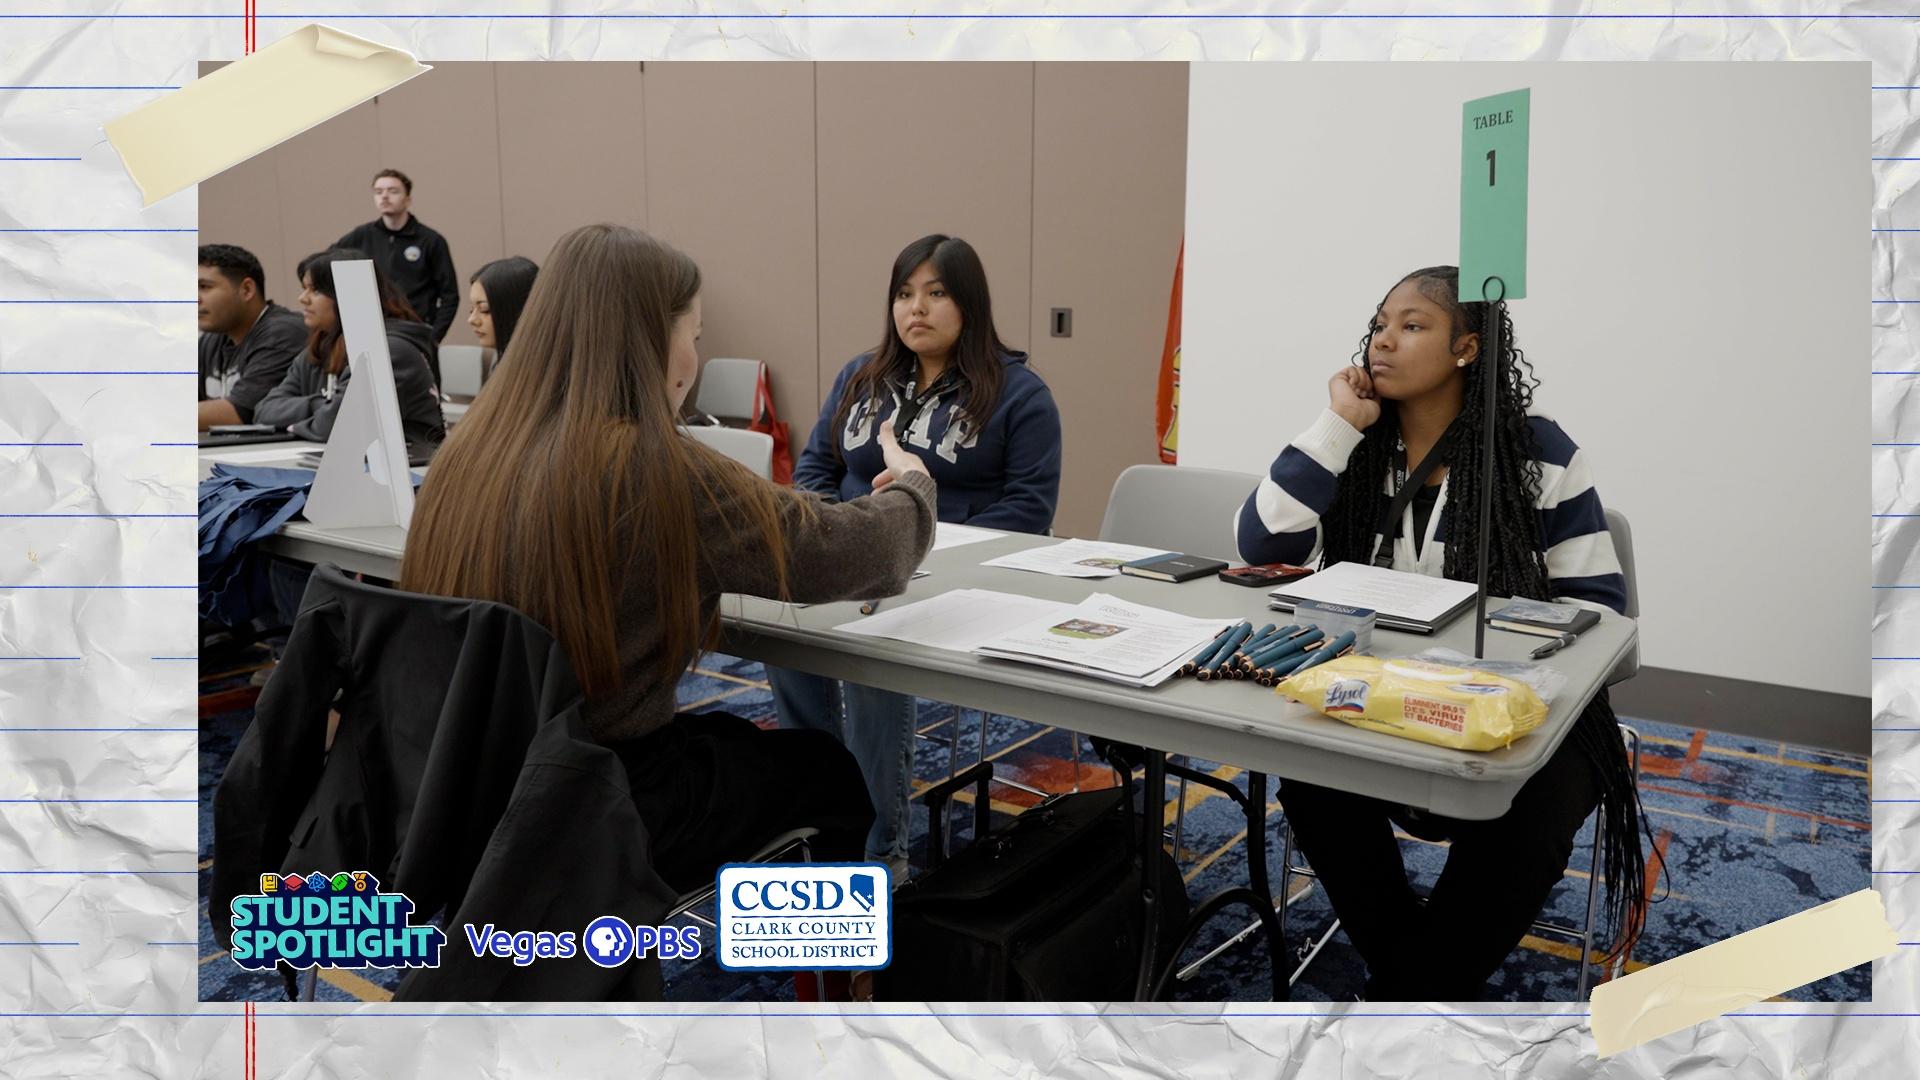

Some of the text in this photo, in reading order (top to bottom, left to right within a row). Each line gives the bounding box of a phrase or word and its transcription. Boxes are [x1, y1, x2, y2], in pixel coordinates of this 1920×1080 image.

[1473, 110, 1514, 130] TABLE
[1486, 149, 1496, 187] 1
[1326, 683, 1367, 704] Lysol
[1404, 705, 1464, 723] DES VIRUS
